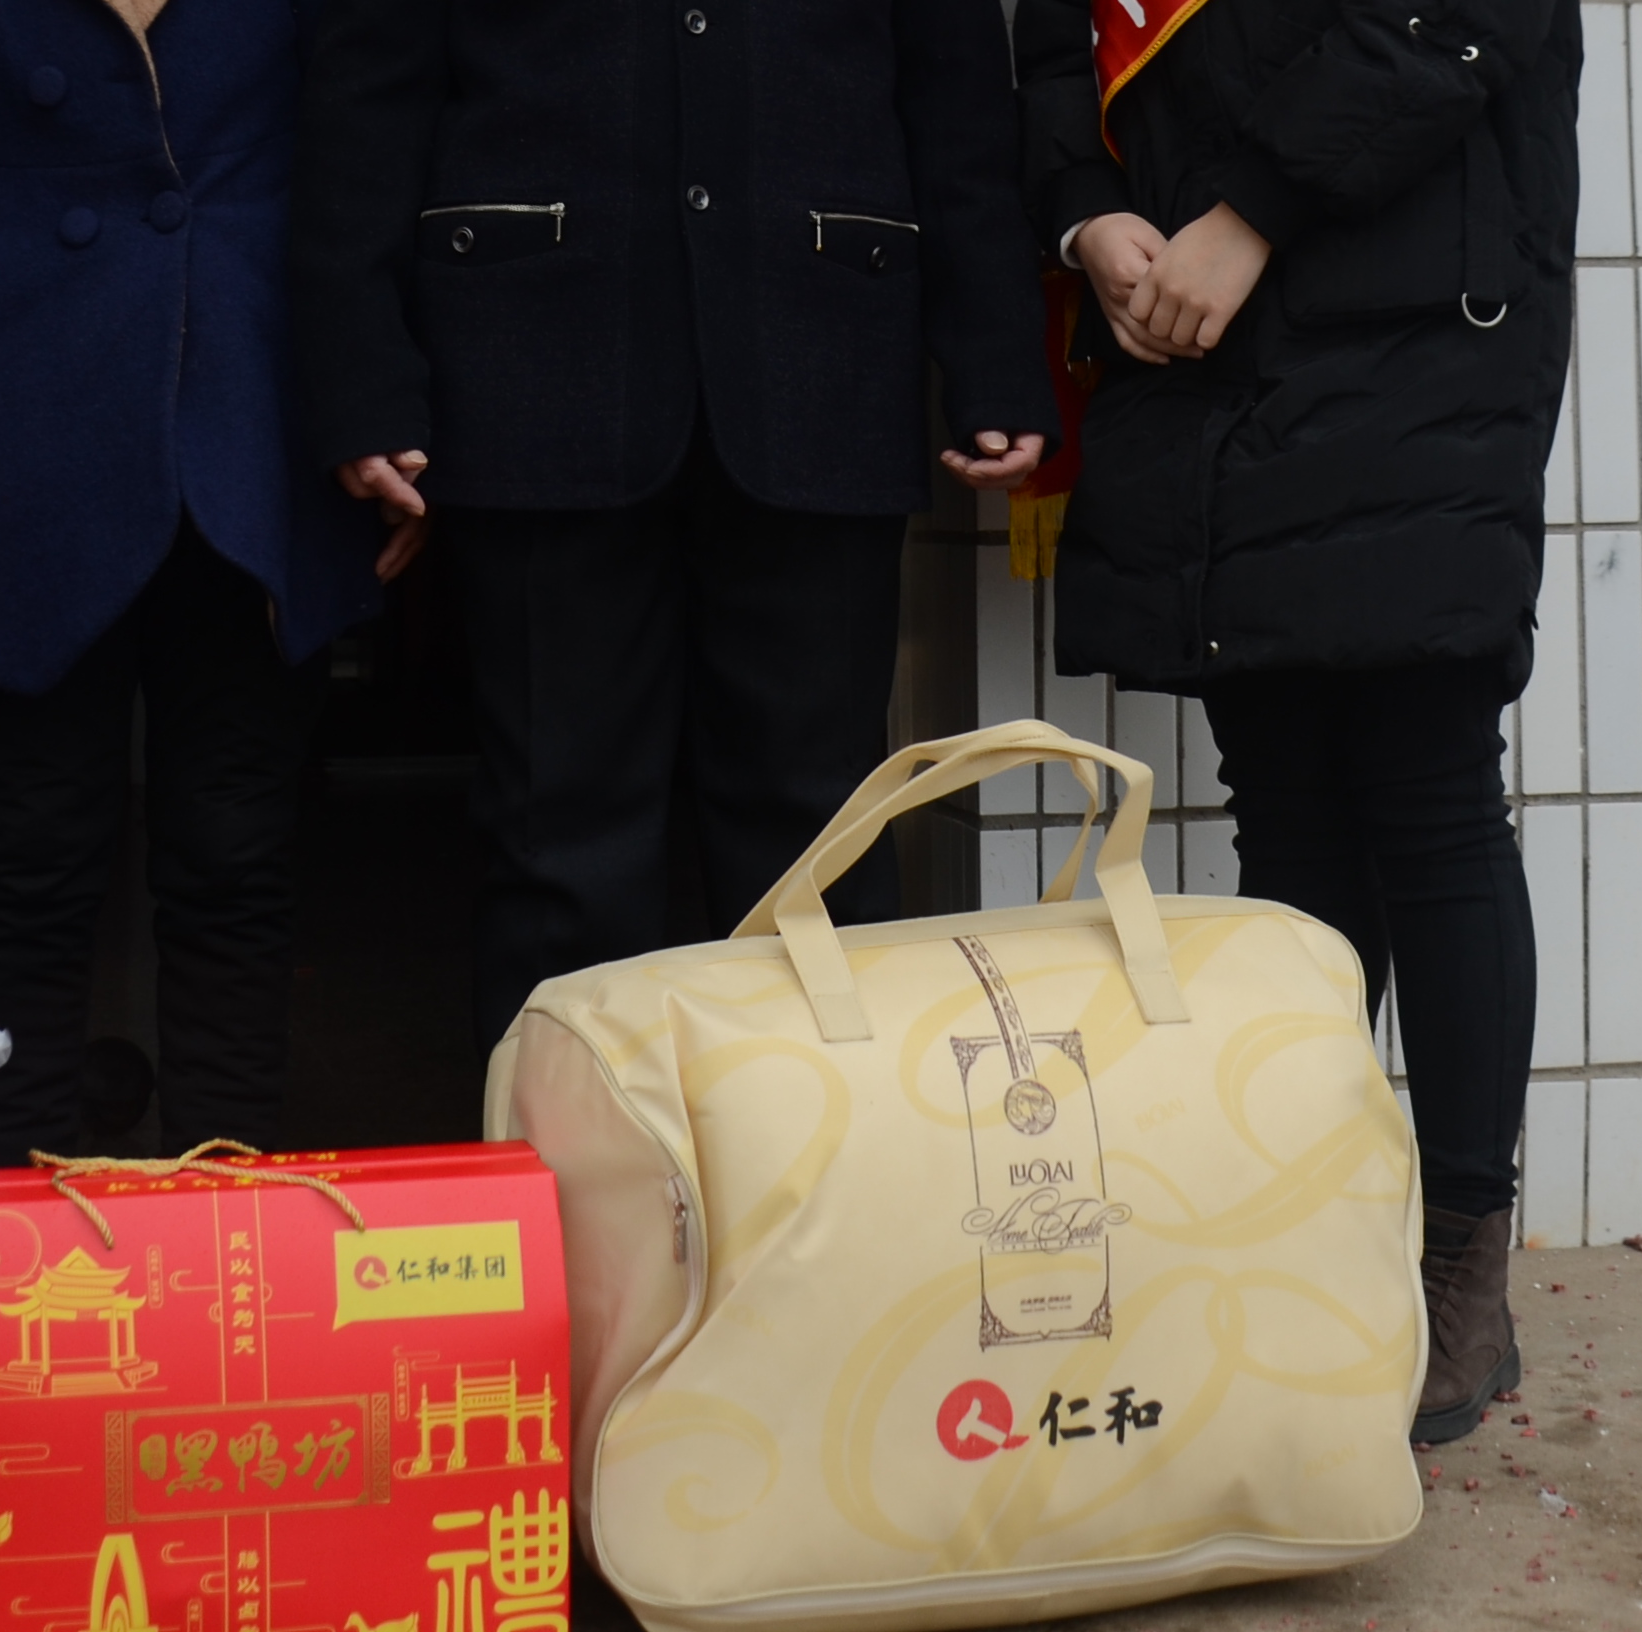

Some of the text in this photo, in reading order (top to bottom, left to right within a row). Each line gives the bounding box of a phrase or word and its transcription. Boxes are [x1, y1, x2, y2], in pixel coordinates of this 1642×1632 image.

[396, 1253, 506, 1284] 仁和集团
[1038, 1385, 1164, 1446] 仁和
